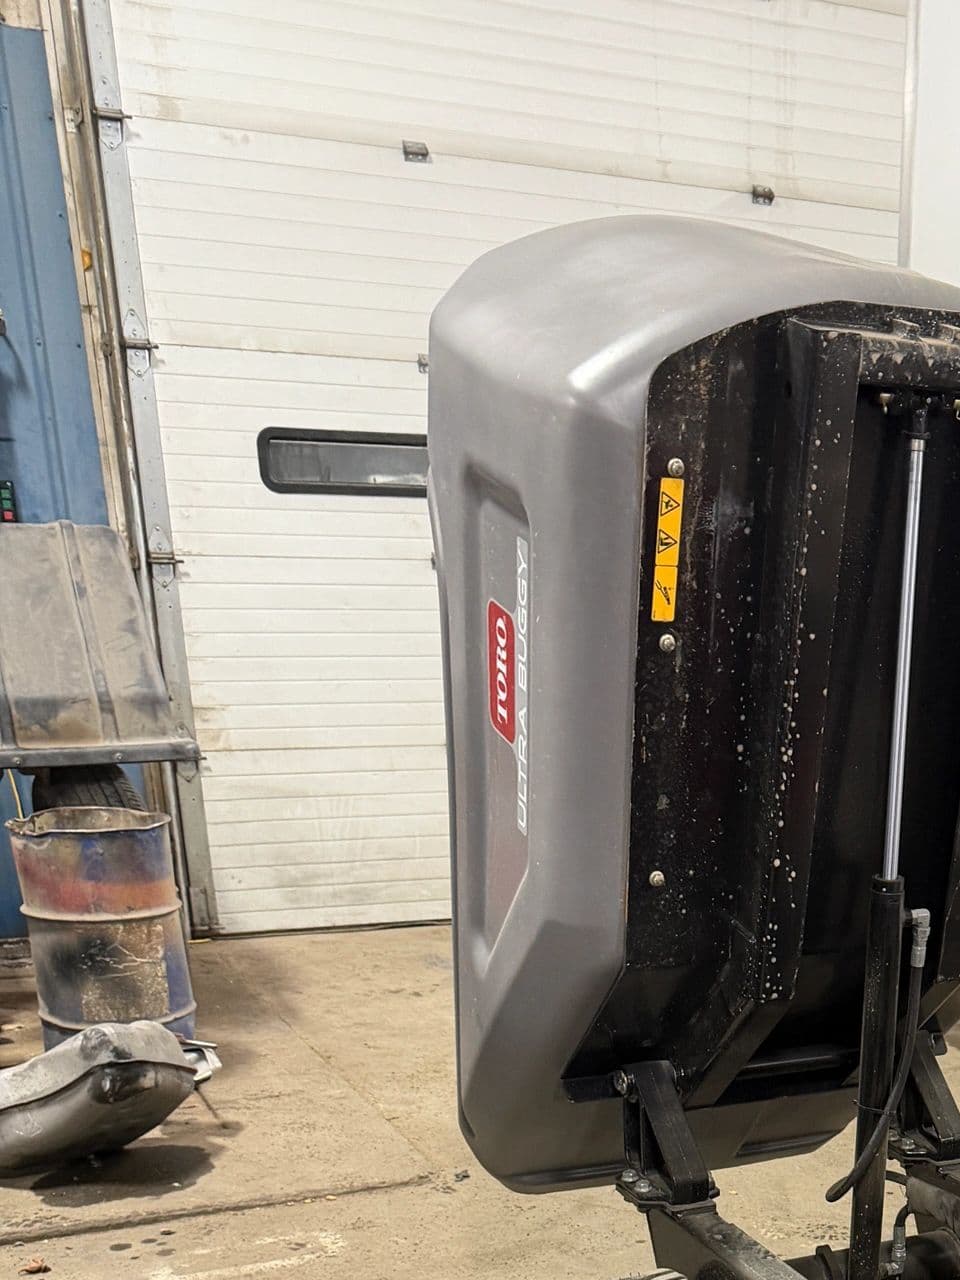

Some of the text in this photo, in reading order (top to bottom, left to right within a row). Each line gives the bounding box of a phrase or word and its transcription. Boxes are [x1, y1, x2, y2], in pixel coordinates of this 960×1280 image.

[495, 615, 508, 724] TORO
[516, 544, 528, 829] ULTRA BUGGY
